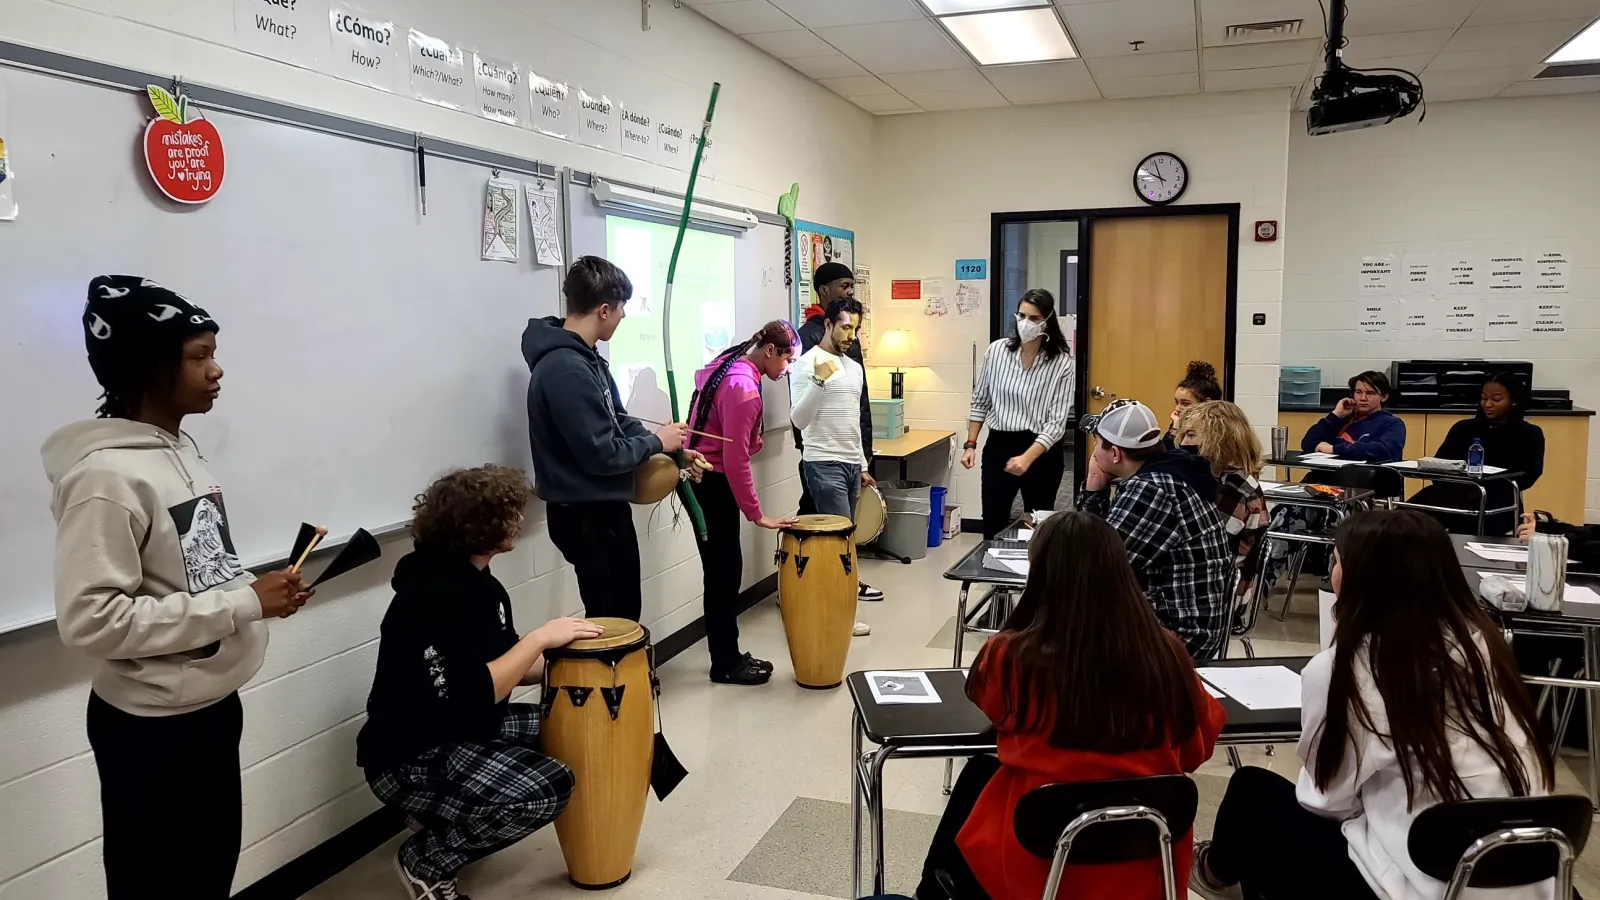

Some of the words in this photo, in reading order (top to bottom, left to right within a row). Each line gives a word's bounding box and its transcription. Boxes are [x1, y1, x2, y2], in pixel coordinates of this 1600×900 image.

[255, 14, 297, 39] What?
[335, 14, 391, 45] ¿Cómo?
[351, 50, 381, 69] How?
[412, 64, 463, 87] Which?/What?
[478, 62, 517, 85] ¿Cuánto?
[482, 86, 495, 97] How
[497, 92, 515, 103] many?
[483, 103, 496, 113] How
[542, 105, 560, 119] Who?
[586, 119, 607, 133] Where?
[621, 110, 629, 120] ¿A
[630, 111, 650, 127] dónde?
[162, 129, 203, 146] mistakes
[658, 123, 682, 139] ¿Cuándo?
[168, 148, 183, 158] are
[185, 141, 210, 164] proof
[664, 143, 679, 154] When?
[168, 160, 185, 179] you
[190, 159, 205, 168] are
[184, 167, 211, 191] trying
[961, 265, 981, 273] 1120
